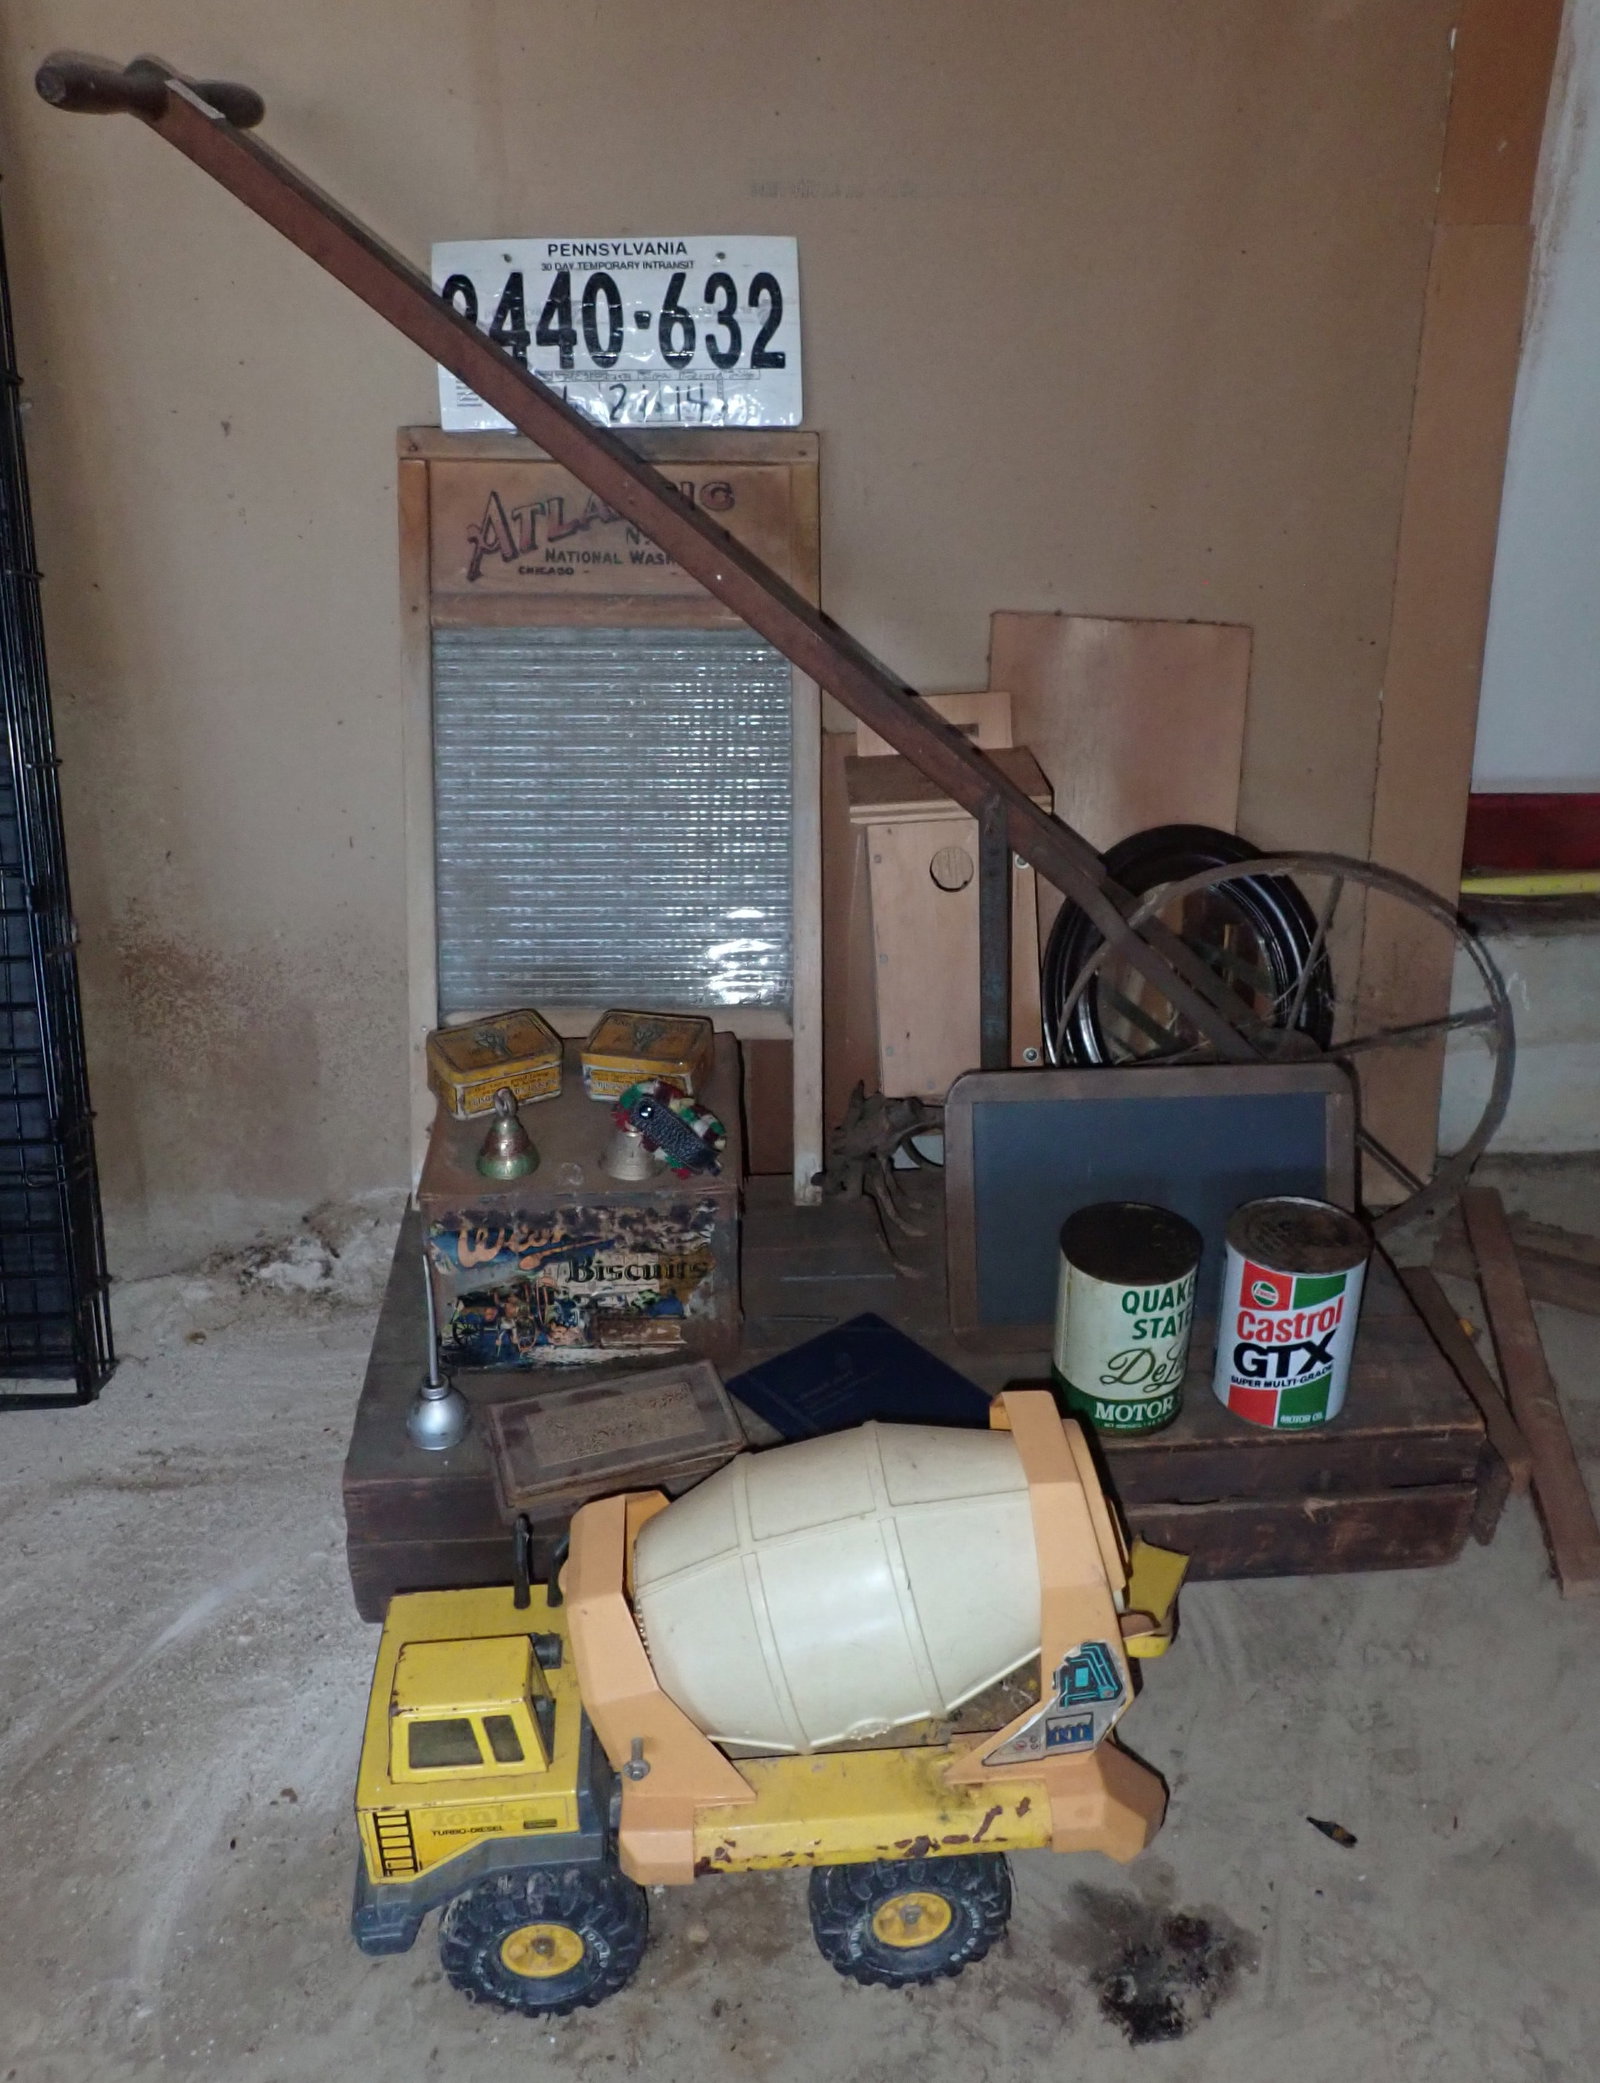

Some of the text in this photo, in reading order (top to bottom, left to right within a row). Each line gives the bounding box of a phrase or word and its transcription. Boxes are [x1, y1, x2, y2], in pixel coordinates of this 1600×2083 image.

[547, 242, 688, 257] PENNSYLVANIA
[541, 260, 695, 271] 30 DAY TEMPORARY INTRANSIT
[545, 549, 623, 564] NATIONAL
[518, 566, 574, 576] CHICAGO
[1236, 1294, 1345, 1344] Castrol
[1233, 1327, 1338, 1379] GTX
[1230, 1375, 1261, 1388] SUPER
[1095, 1395, 1175, 1422] MOTOR
[1280, 1414, 1311, 1424] MOTOR
[431, 1825, 505, 1837] TURBO-DIESEL
